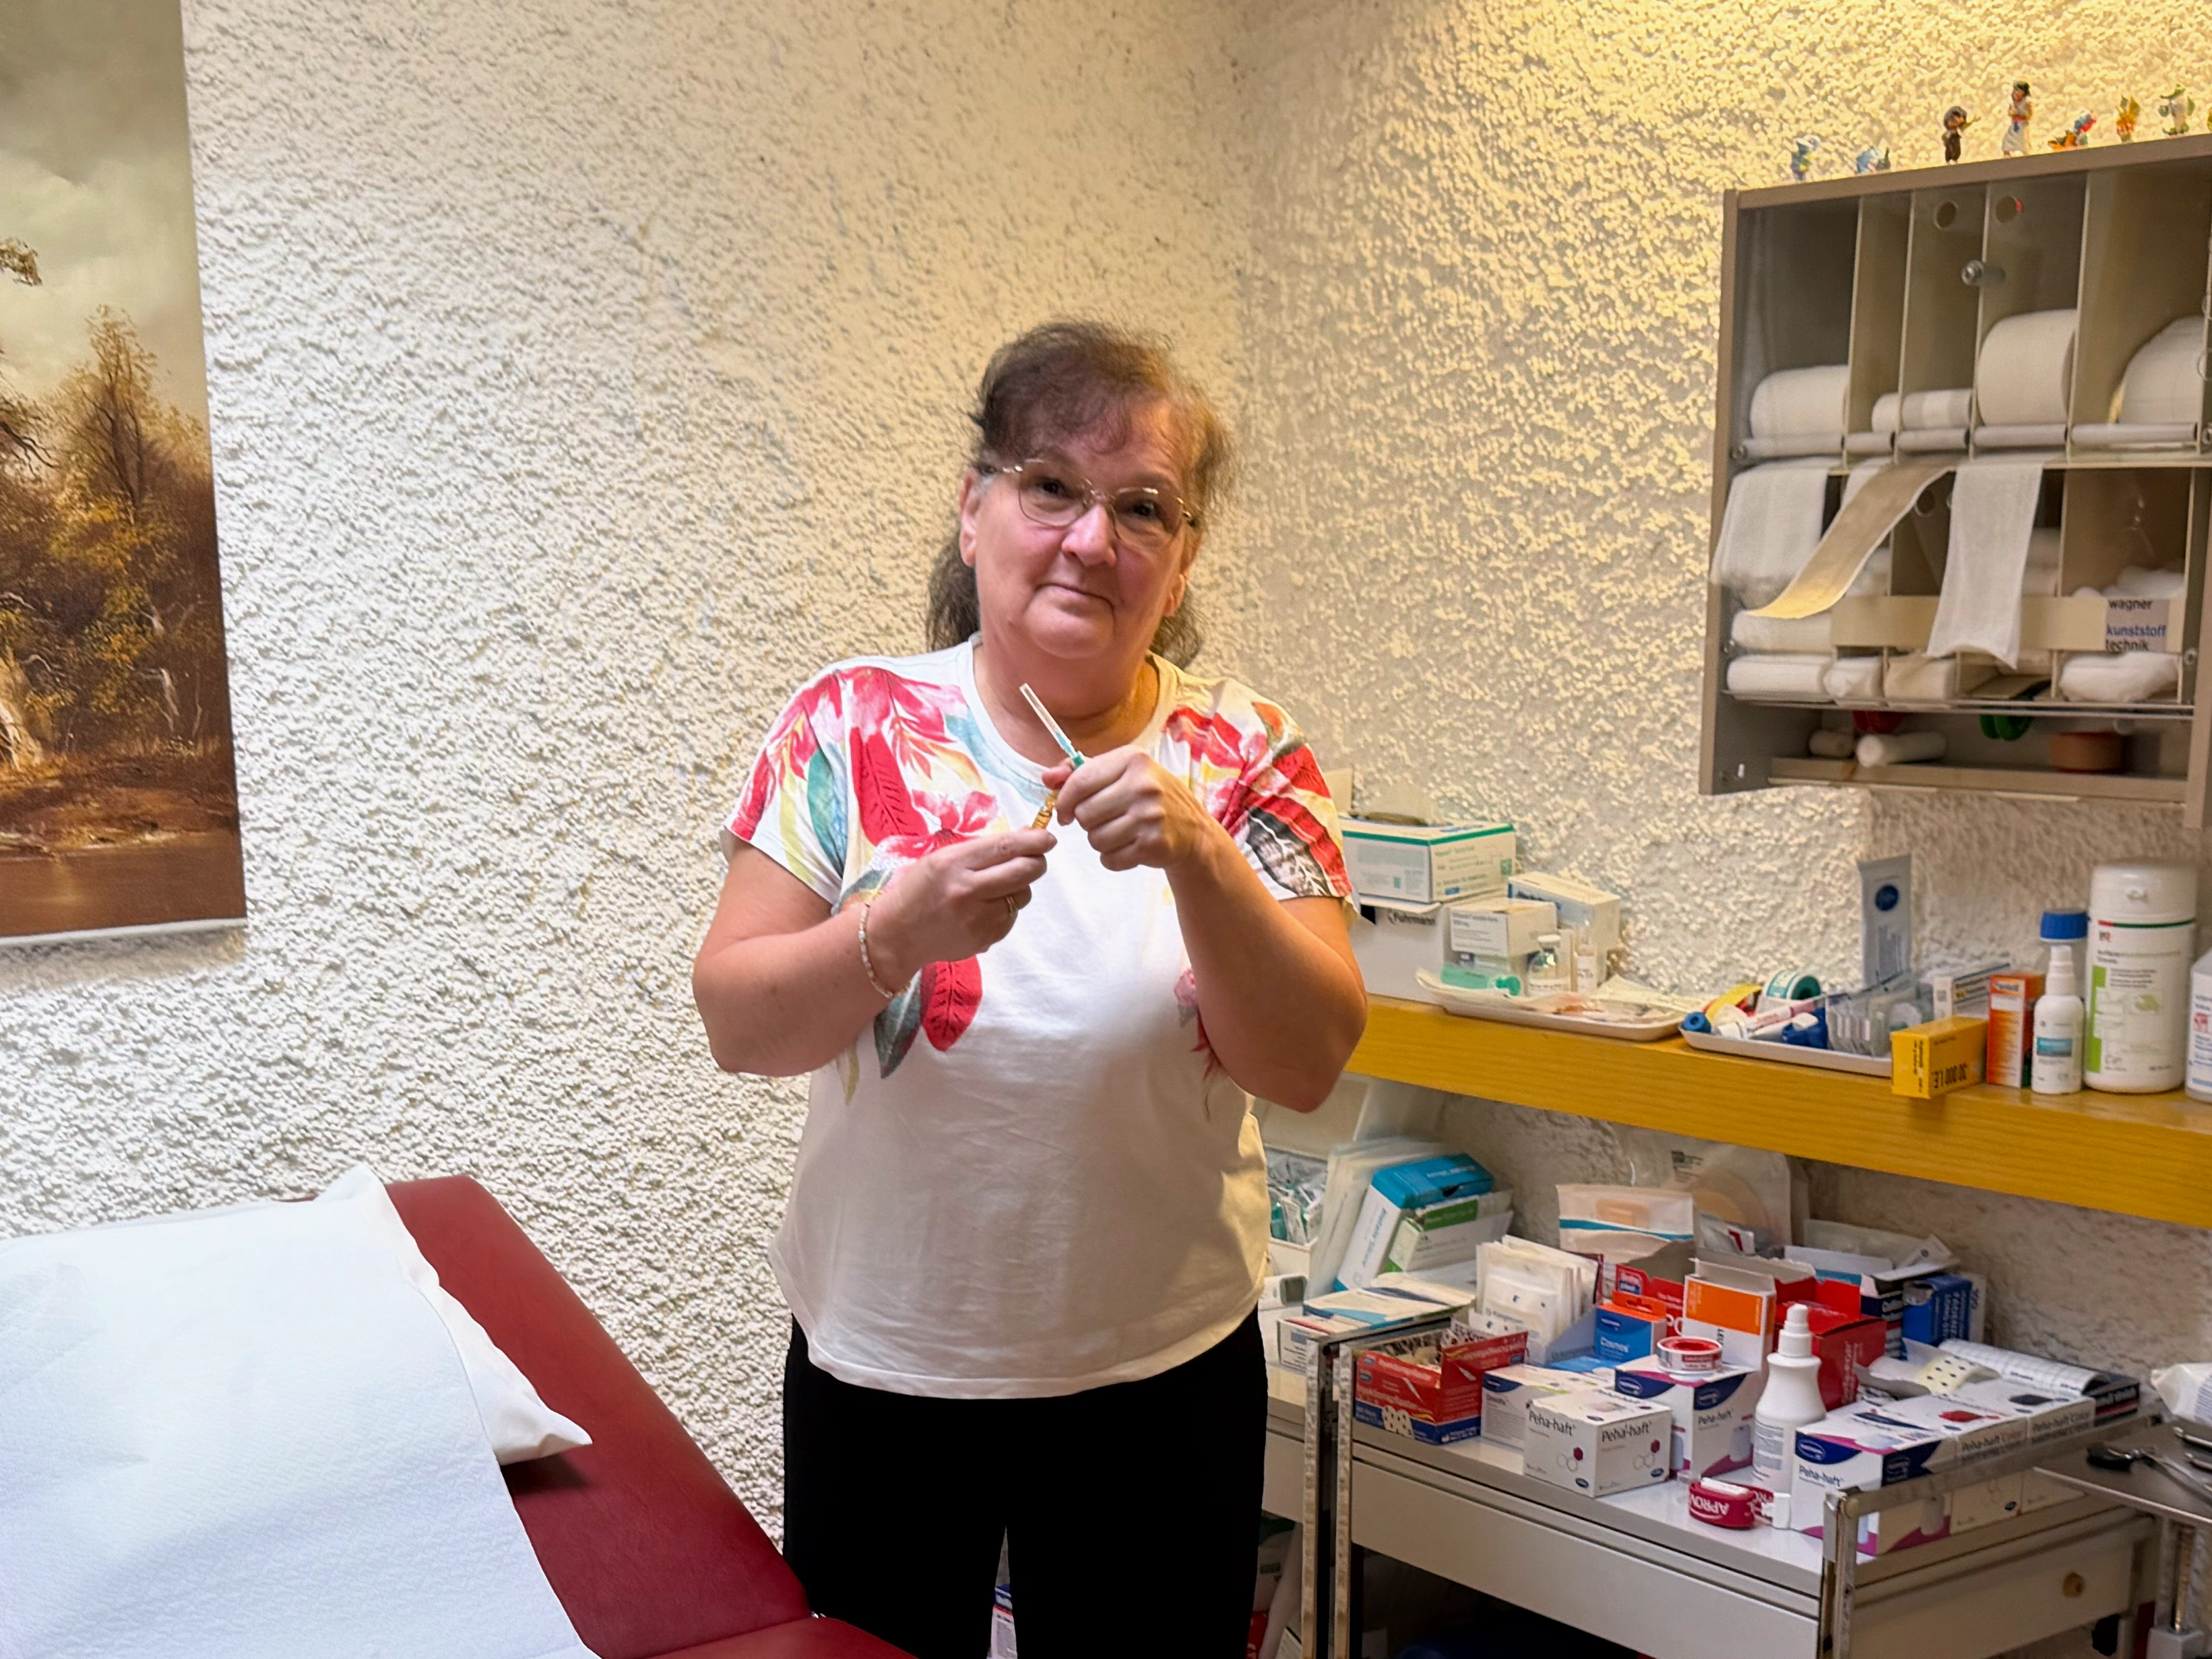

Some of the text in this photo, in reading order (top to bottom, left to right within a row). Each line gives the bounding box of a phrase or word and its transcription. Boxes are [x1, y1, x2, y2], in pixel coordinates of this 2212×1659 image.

[2108, 600, 2152, 611] wagner
[2107, 624, 2167, 637] kunststoff
[2106, 639, 2149, 653] technik
